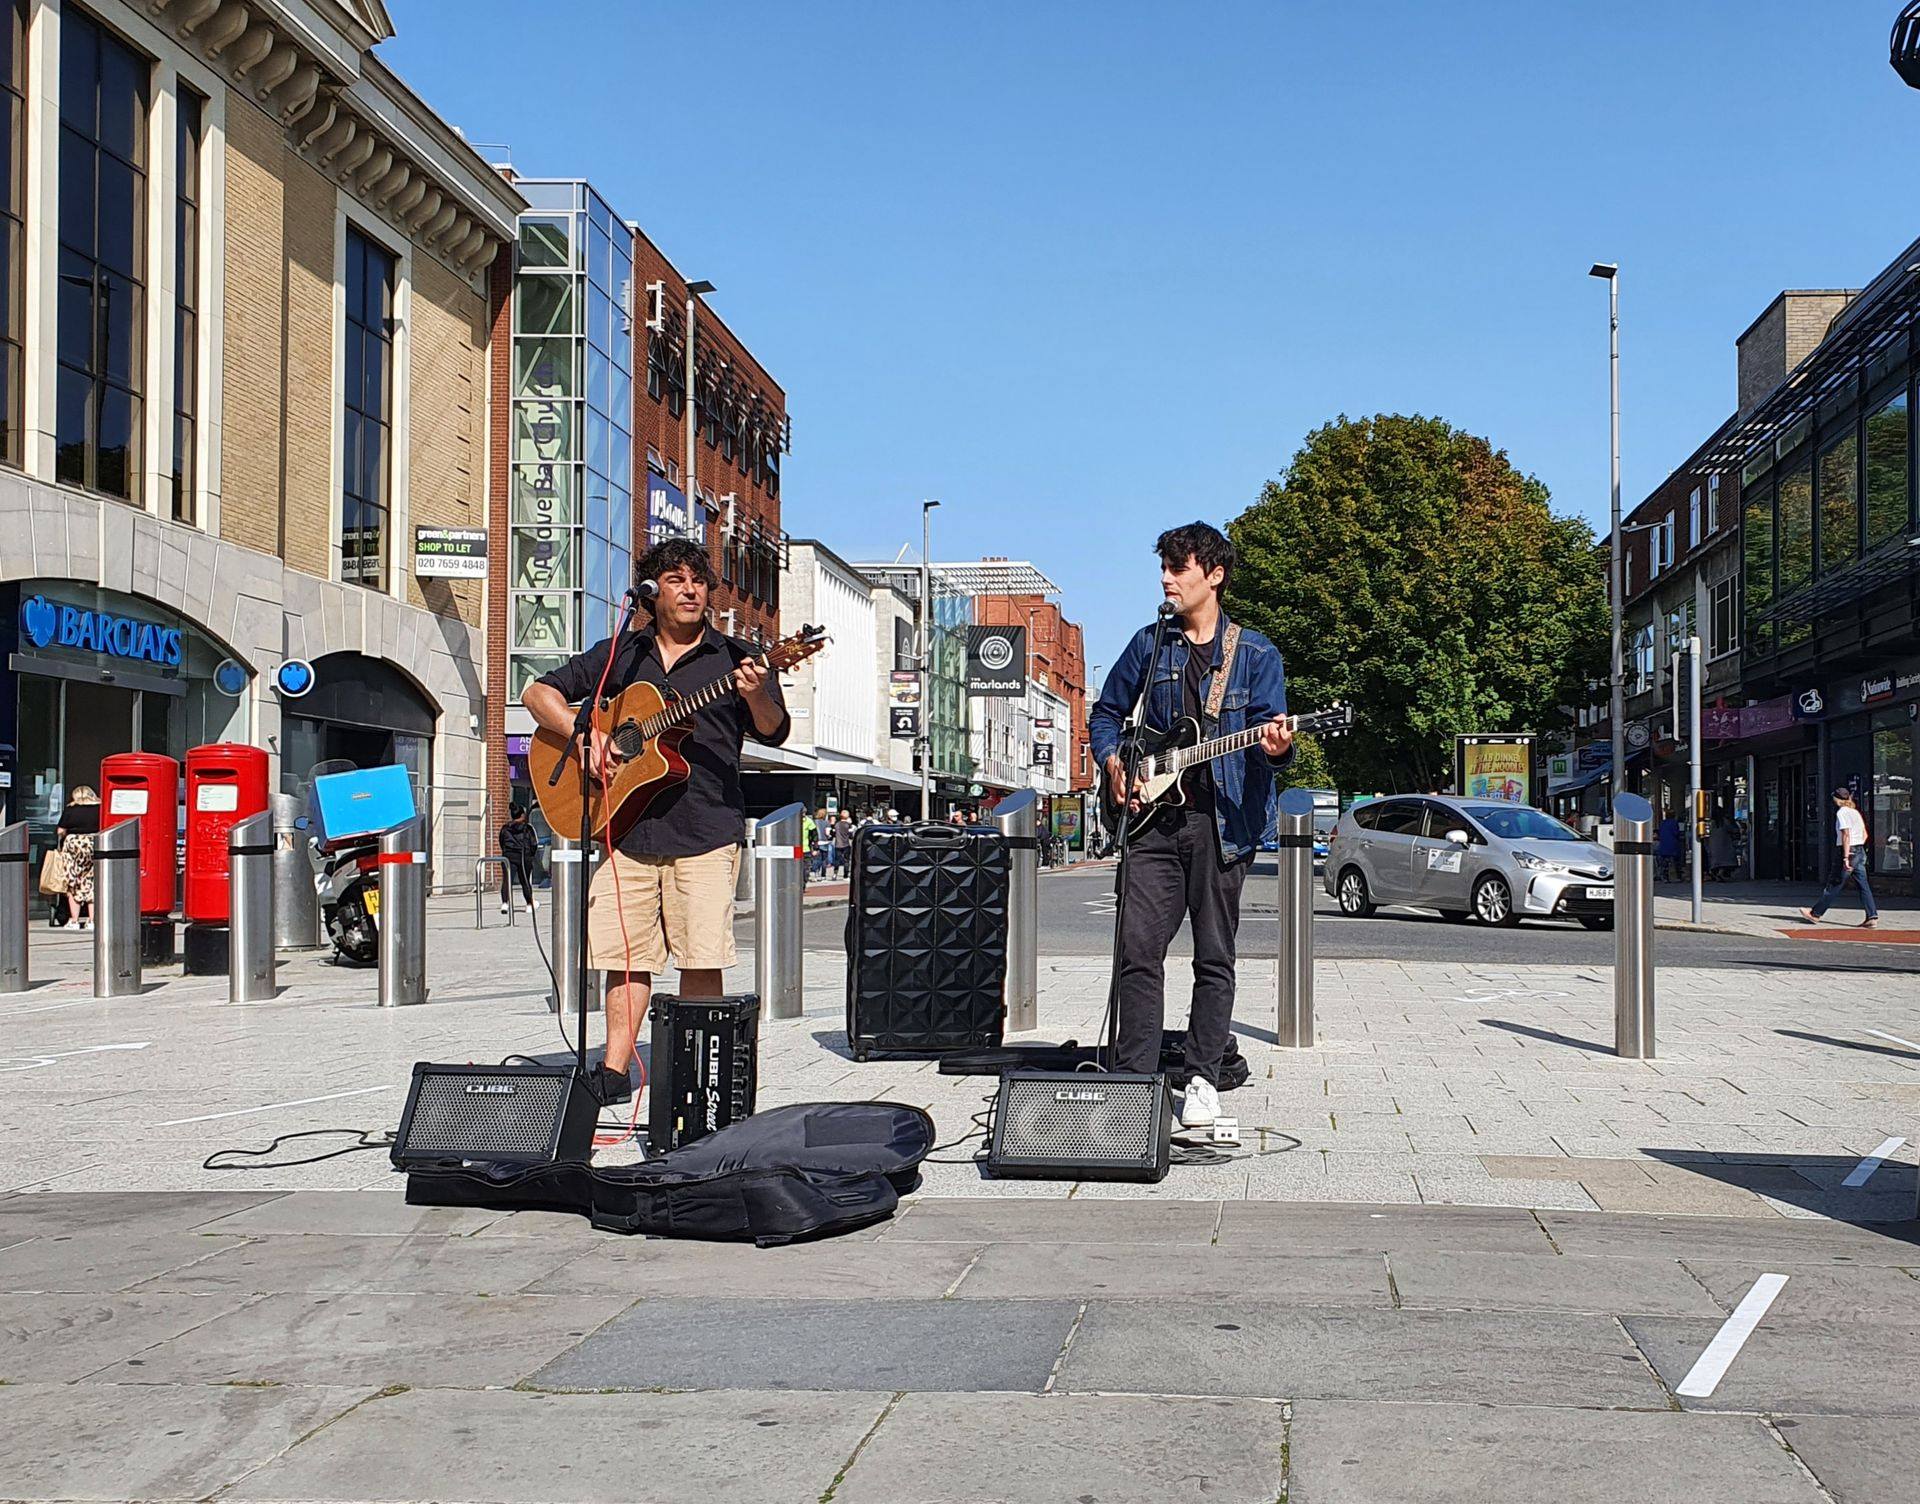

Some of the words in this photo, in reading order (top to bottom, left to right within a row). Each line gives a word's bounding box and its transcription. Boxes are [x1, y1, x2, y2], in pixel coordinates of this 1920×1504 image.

[418, 542, 442, 552] SHOP
[442, 543, 455, 553] TO
[456, 544, 472, 553] LET
[418, 558, 435, 568] 020
[438, 559, 460, 569] 7659
[461, 560, 486, 570] 4848
[59, 606, 182, 666] BARCLAYS
[970, 679, 1021, 690] marlands
[708, 1035, 720, 1087] CUBE
[466, 1084, 515, 1094] CUBE
[1055, 1091, 1106, 1101] CUBE
[705, 1086, 721, 1132] Street
